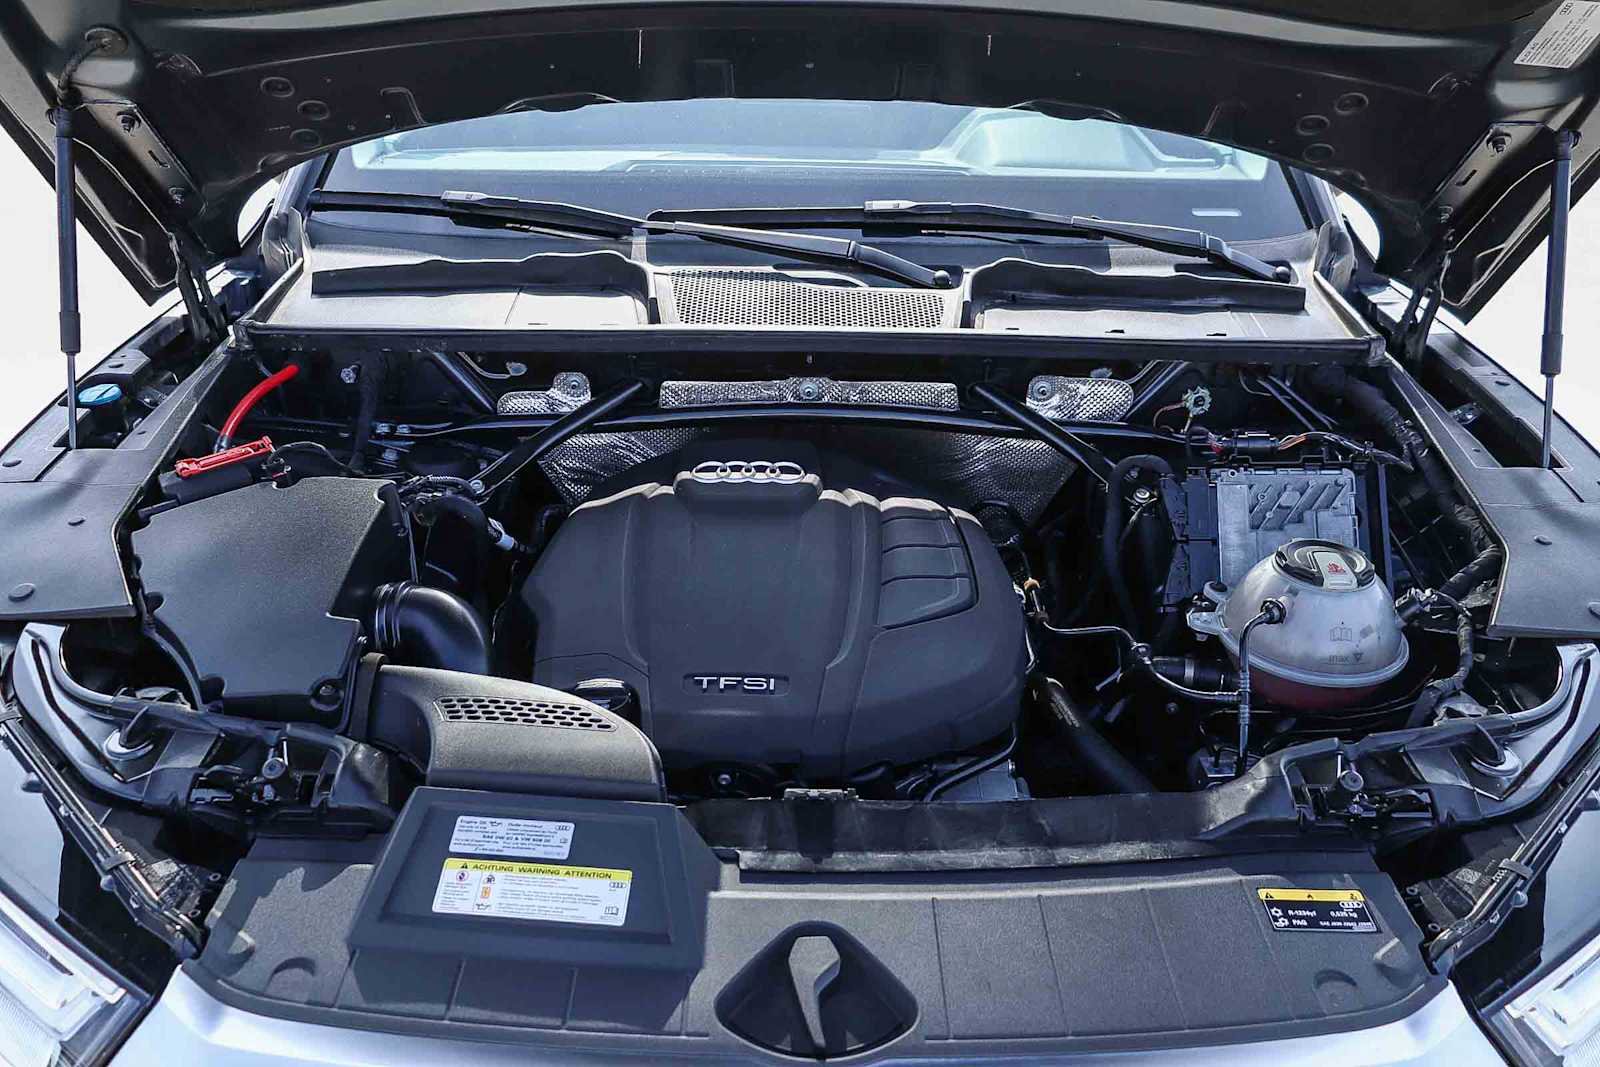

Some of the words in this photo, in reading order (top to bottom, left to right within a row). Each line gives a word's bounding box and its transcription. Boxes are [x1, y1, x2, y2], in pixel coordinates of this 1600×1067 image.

[693, 676, 775, 690] TFSI
[472, 863, 514, 873] ACHTUNG
[518, 866, 561, 876] WARNING
[564, 869, 613, 880] ATTENTION
